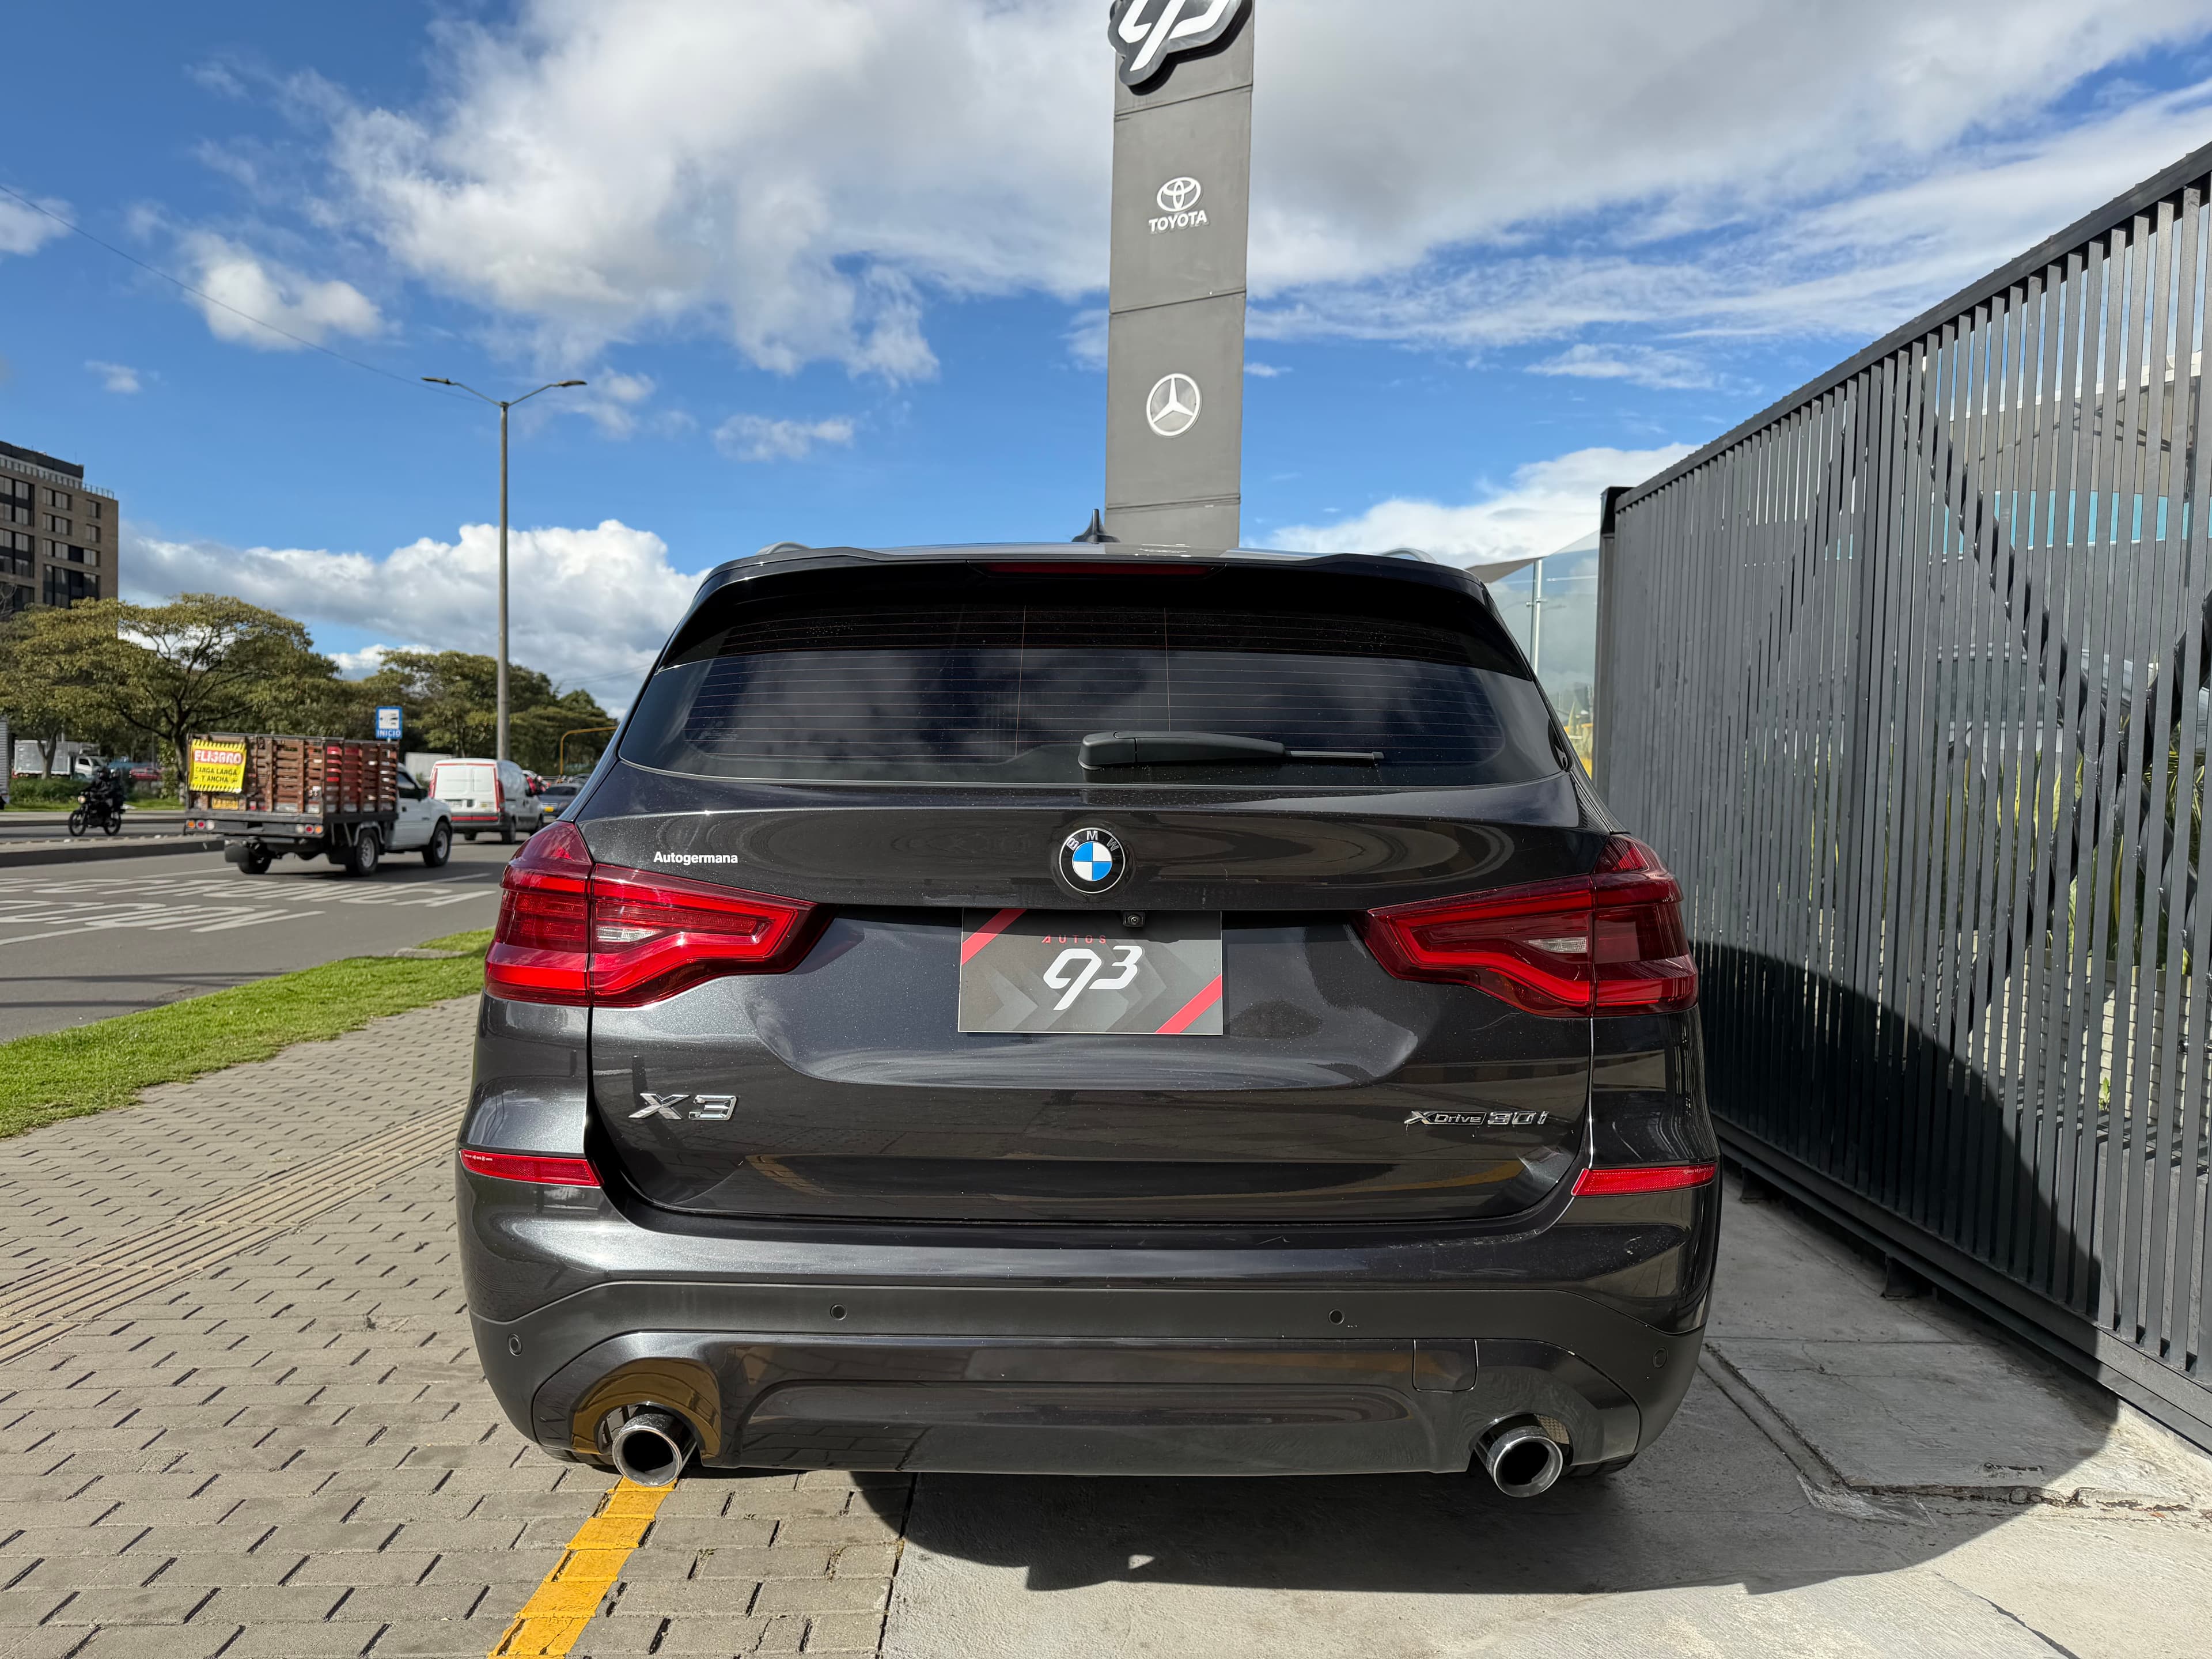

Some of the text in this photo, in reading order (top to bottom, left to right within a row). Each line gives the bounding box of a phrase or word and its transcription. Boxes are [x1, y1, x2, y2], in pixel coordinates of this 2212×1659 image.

[1148, 210, 1207, 232] TOYOTA
[377, 729, 402, 737] INICIO
[1066, 830, 1120, 851] BMW
[653, 851, 738, 866] Autogermana
[1041, 934, 1107, 944] AUTOS
[1043, 945, 1143, 1010] 93
[628, 1092, 738, 1121] X3
